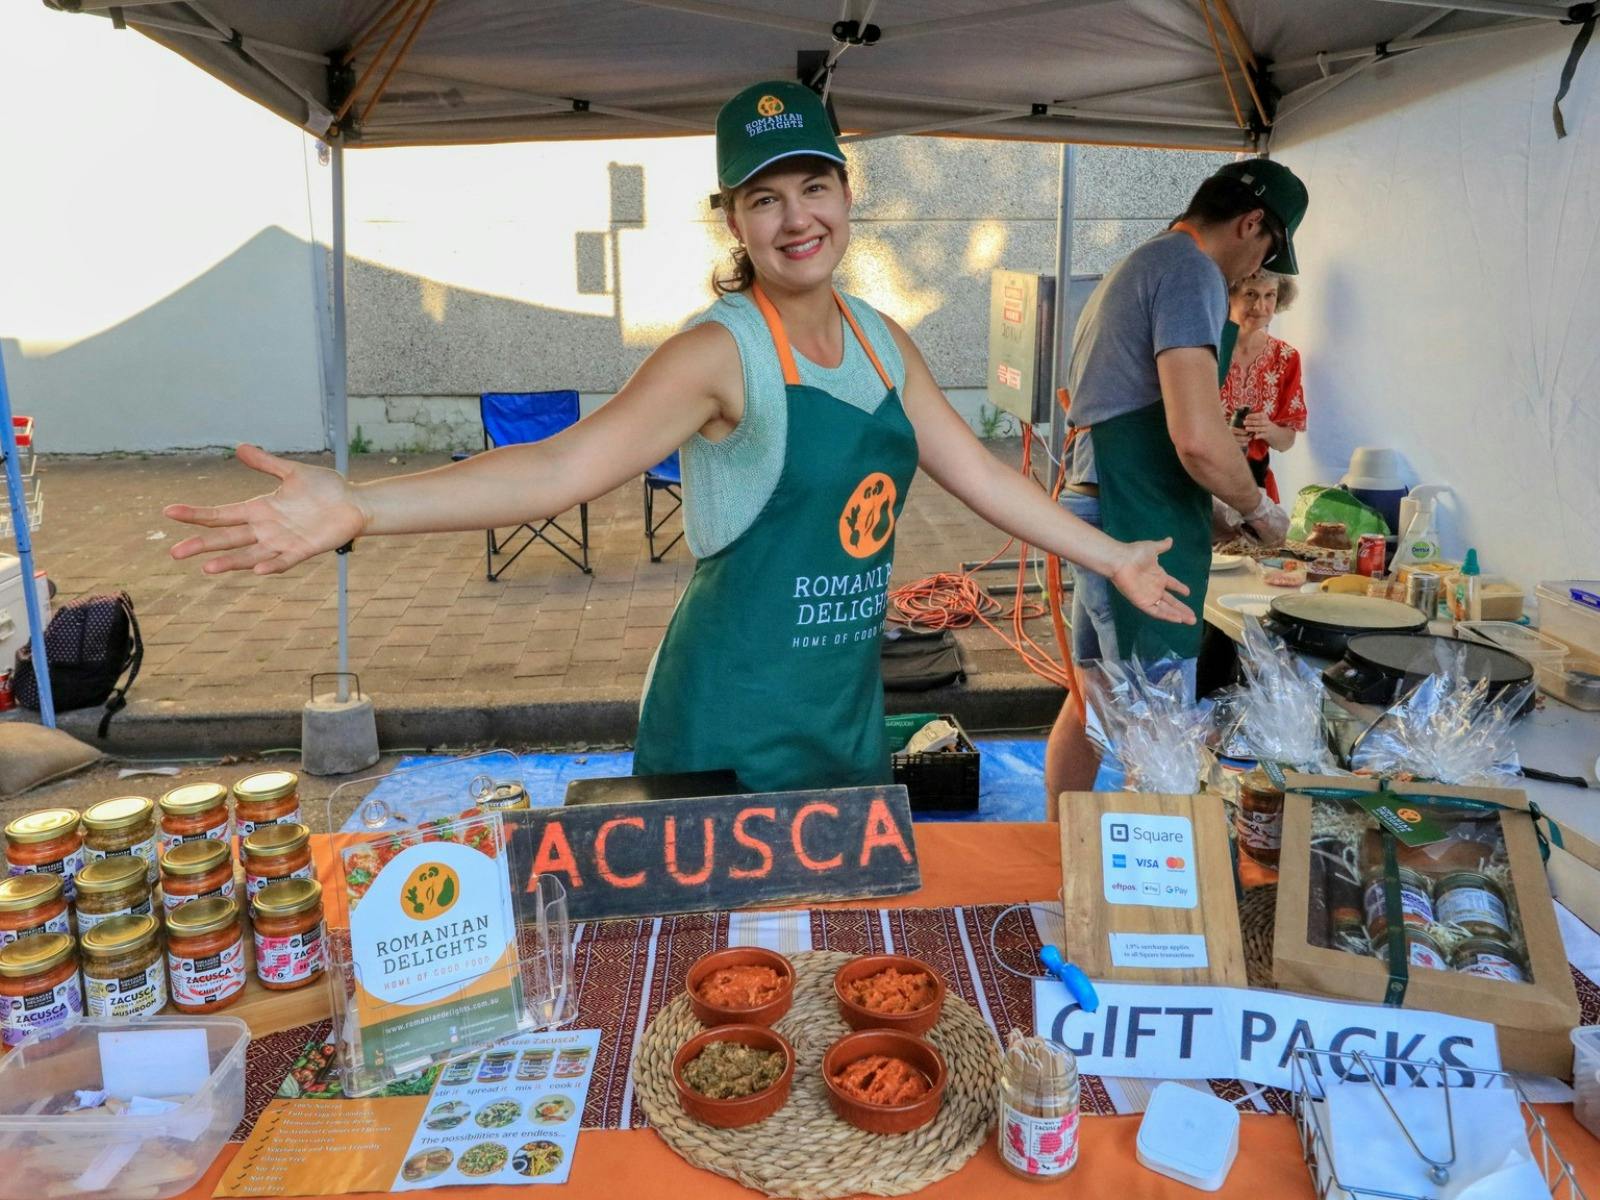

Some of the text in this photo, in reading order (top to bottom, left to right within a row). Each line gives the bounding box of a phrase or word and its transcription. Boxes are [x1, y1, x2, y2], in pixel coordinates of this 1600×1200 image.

[745, 113, 803, 132] ROMANIAN
[749, 120, 804, 137] DELIGHTS
[792, 563, 892, 598] ROMANIA
[796, 592, 887, 625] DELIGH
[792, 627, 877, 648] HOME OF GOOD
[506, 796, 912, 893] ACUSCA
[1133, 827, 1184, 844] Square
[1136, 858, 1159, 869] VISA
[1112, 882, 1136, 893] eftpos
[376, 915, 489, 958] ROMANIAN
[383, 934, 488, 975] DELIGHTS
[186, 968, 231, 984] ZACUSCA
[384, 978, 411, 991] HOME
[417, 972, 428, 982] OF
[434, 963, 460, 977] GOOD
[110, 984, 156, 1005] ZACUSCA
[16, 1002, 67, 1024] ZACUSCA
[112, 998, 157, 1017] MUSHROOM
[1051, 1002, 1476, 1088] GIFT PACKS
[435, 1088, 451, 1097] stir
[467, 1085, 499, 1096] spread
[549, 1081, 572, 1089] cook
[421, 1137, 439, 1145] The
[441, 1131, 500, 1144] possibilities
